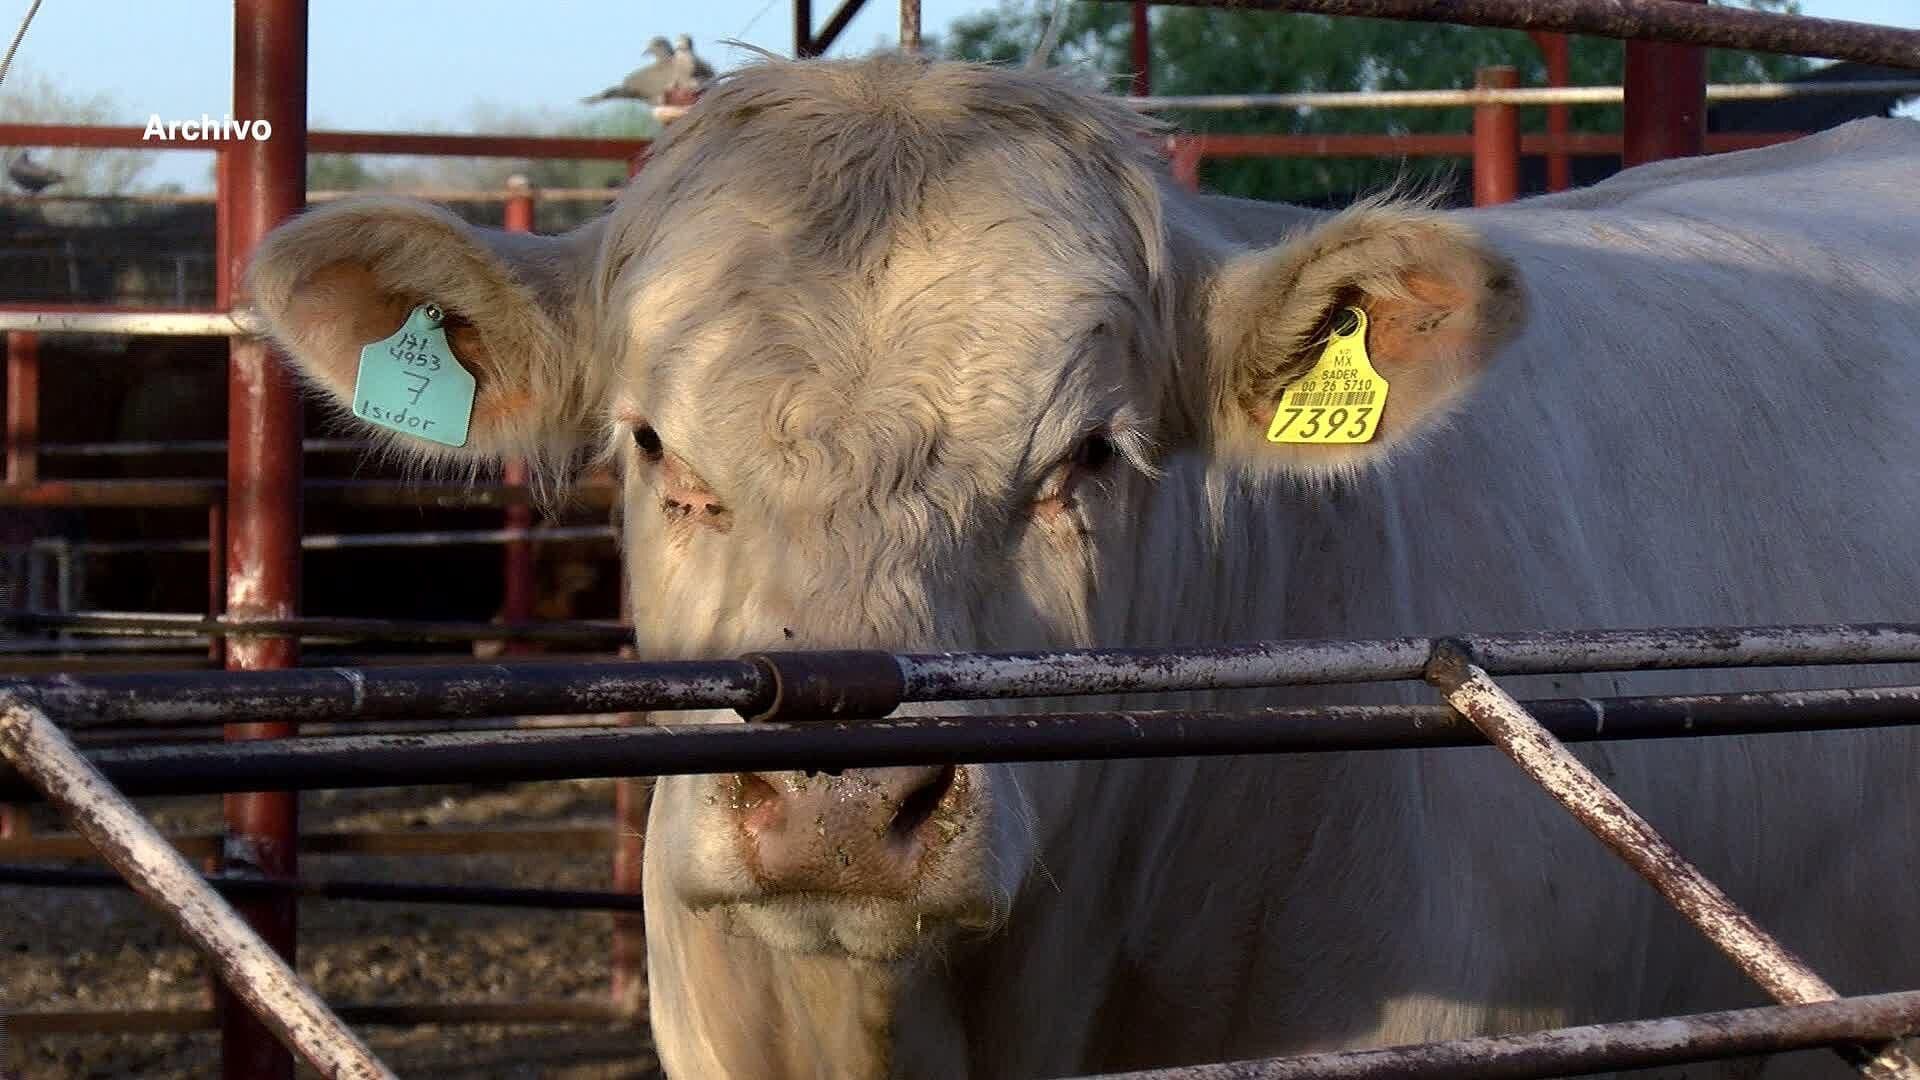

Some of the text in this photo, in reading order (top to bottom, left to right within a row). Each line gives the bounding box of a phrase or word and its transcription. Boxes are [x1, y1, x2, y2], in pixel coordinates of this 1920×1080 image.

[389, 345, 441, 371] 4953
[1334, 355, 1352, 367] MX
[1302, 379, 1372, 392] 00 26 5710
[1321, 369, 1358, 379] SADER
[402, 370, 430, 405] 7
[361, 400, 436, 430] Isidor
[1274, 407, 1373, 439] 7393
